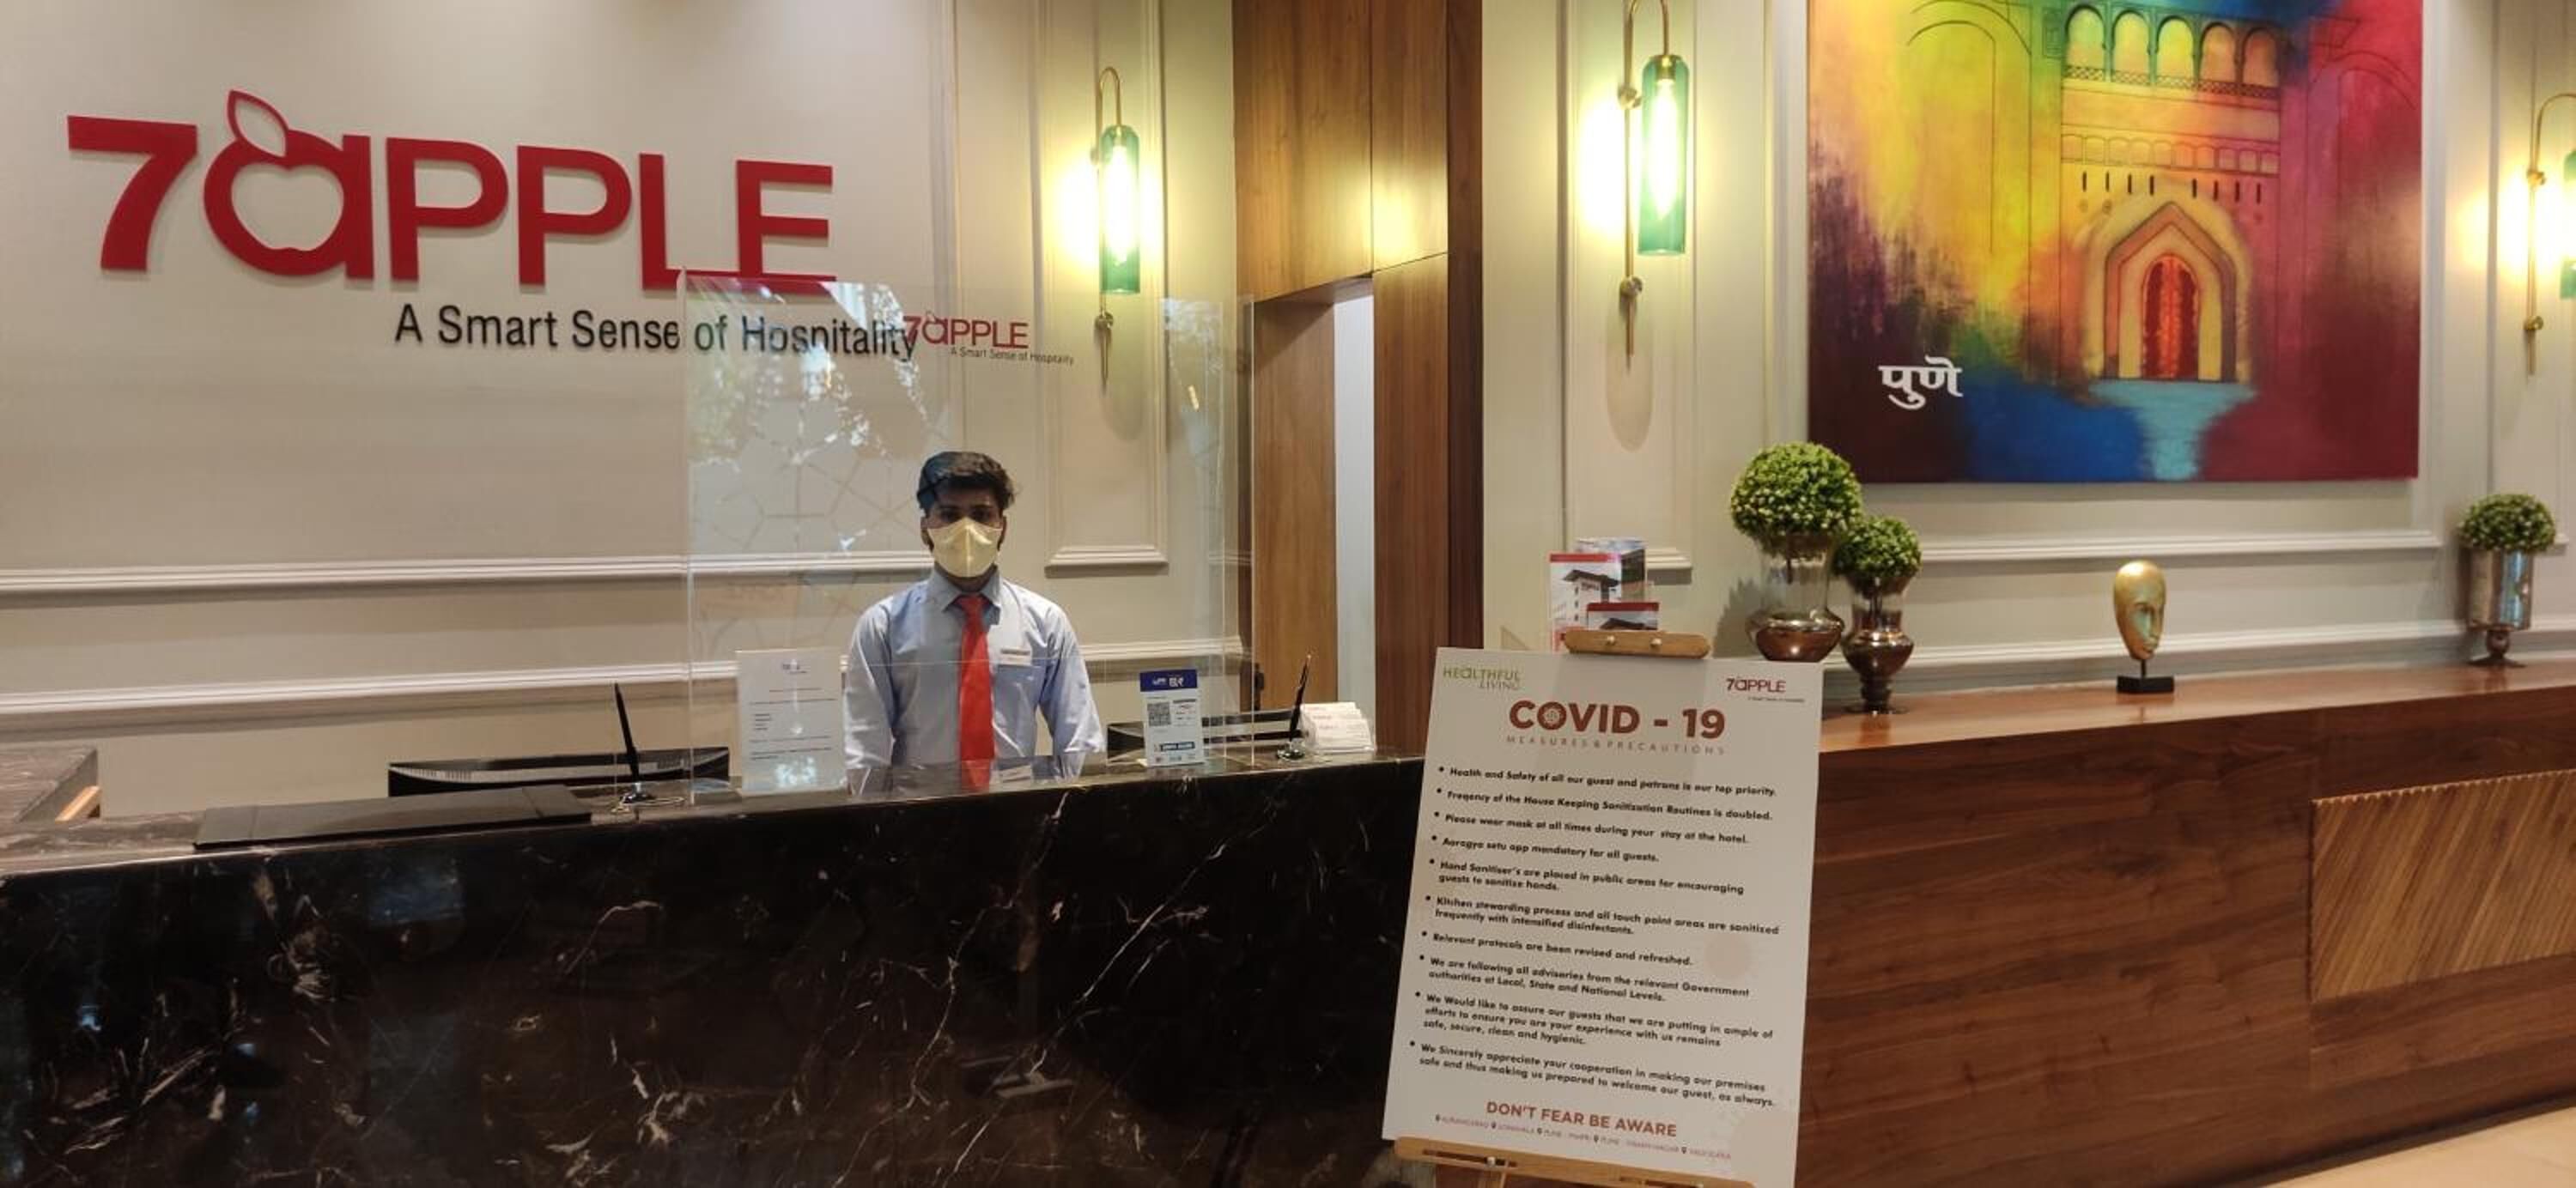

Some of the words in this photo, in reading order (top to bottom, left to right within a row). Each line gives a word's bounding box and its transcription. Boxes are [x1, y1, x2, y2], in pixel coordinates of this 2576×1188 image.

[394, 304, 423, 343] A
[437, 305, 559, 348] Smart
[571, 310, 680, 350] Sense
[694, 314, 728, 351] of
[741, 315, 918, 362] Hospitality
[951, 347, 957, 355] A
[960, 348, 987, 358] Smart
[989, 350, 1017, 361] Sense
[1019, 351, 1028, 361] of
[1878, 356, 1963, 409] पुणे
[1479, 680, 1520, 690] LIVING
[1509, 700, 1640, 734] COVID
[1654, 718, 1668, 727] -
[1682, 708, 1725, 739] 19
[1507, 736, 1588, 748] MEASURES
[1607, 742, 1725, 755] PRECAUTIONS
[1449, 766, 1482, 777] Health
[1484, 769, 1504, 778] and
[1506, 770, 1536, 783] Safety
[1551, 773, 1564, 782] all
[1586, 777, 1614, 786] guest
[1616, 778, 1637, 786] and
[1639, 779, 1680, 790] patrons
[1715, 784, 1733, 796] top
[1504, 794, 1521, 803] the
[1523, 795, 1554, 805] House
[1557, 797, 1600, 811] Keeping
[1666, 804, 1711, 815] Routines
[1444, 813, 1477, 824] Please
[1506, 819, 1534, 828] mask
[1548, 821, 1562, 830] all
[1564, 822, 1592, 833] times
[1594, 824, 1629, 838] during
[1631, 829, 1655, 839] your
[1660, 830, 1681, 842] stay
[1698, 832, 1716, 841] the
[1486, 841, 1507, 850] setu
[1509, 844, 1529, 854] app
[1531, 845, 1587, 858] mandatory
[1589, 846, 1605, 857] for
[1606, 848, 1620, 858] all
[1438, 875, 1470, 884] guests
[1485, 877, 1524, 888] sanitise
[1439, 860, 1467, 870] Hand
[1542, 869, 1577, 880] placed
[1592, 873, 1623, 884] public
[1625, 877, 1656, 886] areas
[1658, 877, 1674, 887] for
[1676, 881, 1744, 895] encouraging
[1434, 908, 1485, 924] frequently
[1487, 913, 1509, 923] with
[1510, 914, 1564, 928] intensified
[1436, 895, 1473, 907] Kitchen
[1475, 900, 1531, 915] stewarding
[1533, 906, 1571, 916] process
[1573, 909, 1594, 918] and
[1596, 910, 1610, 919] all
[1613, 912, 1641, 922] touch
[1643, 915, 1672, 925] point
[1674, 919, 1705, 928] areas
[1728, 923, 1779, 935] sanitised
[1432, 932, 1475, 944] Relevant
[1477, 938, 1523, 949] protocols
[1546, 943, 1571, 953] been
[1574, 946, 1613, 957] revised
[1614, 950, 1636, 959] and
[1428, 970, 1482, 982] authorities
[1528, 979, 1555, 990] State
[1557, 984, 1578, 992] and
[1580, 985, 1626, 997] National
[1430, 956, 1445, 966] We
[1467, 960, 1514, 975] following
[1516, 965, 1529, 974] all
[1531, 967, 1584, 979] advisories
[1586, 971, 1612, 982] from
[1613, 974, 1631, 984] the
[1633, 977, 1679, 989] relevant
[1681, 980, 1749, 996] Government
[1425, 993, 1441, 1003] We
[1443, 996, 1475, 1007] Would
[1477, 998, 1496, 1009] like
[1510, 1004, 1545, 1014] assure
[1568, 1010, 1601, 1020] guests
[1604, 1013, 1625, 1022] that
[1668, 1021, 1707, 1033] putting
[1710, 1023, 1721, 1033] in
[1723, 1027, 1759, 1038] ample
[1761, 1029, 1772, 1038] of
[1425, 1006, 1456, 1017] efforts
[1458, 1009, 1469, 1019] to
[1471, 1013, 1505, 1022] ensure
[1508, 1017, 1527, 1026] you
[1549, 1021, 1573, 1031] your
[1575, 1024, 1632, 1036] experience
[1635, 1029, 1658, 1039] with
[1675, 1035, 1721, 1046] remains
[1487, 1026, 1516, 1036] clean
[1517, 1030, 1538, 1039] and
[1419, 1057, 1440, 1066] safe
[1443, 1060, 1462, 1069] and
[1465, 1061, 1486, 1072] thus
[1489, 1066, 1528, 1079] making
[1545, 1073, 1595, 1084] prepared
[1597, 1077, 1607, 1086] to
[1611, 1080, 1657, 1092] welcome
[1420, 1043, 1437, 1052] We
[1438, 1045, 1484, 1061] Sincerely
[1485, 1052, 1540, 1064] appreciate
[1542, 1059, 1566, 1069] your
[1569, 1063, 1632, 1076] cooperation
[1635, 1067, 1646, 1077] in
[1649, 1071, 1691, 1085] making
[1693, 1076, 1712, 1085] our
[1715, 1079, 1765, 1091] premises
[1486, 1101, 1537, 1119] DON'T
[1540, 1108, 1584, 1125] FEAR
[1589, 1114, 1611, 1129] BE
[1614, 1118, 1677, 1137] AWARE
